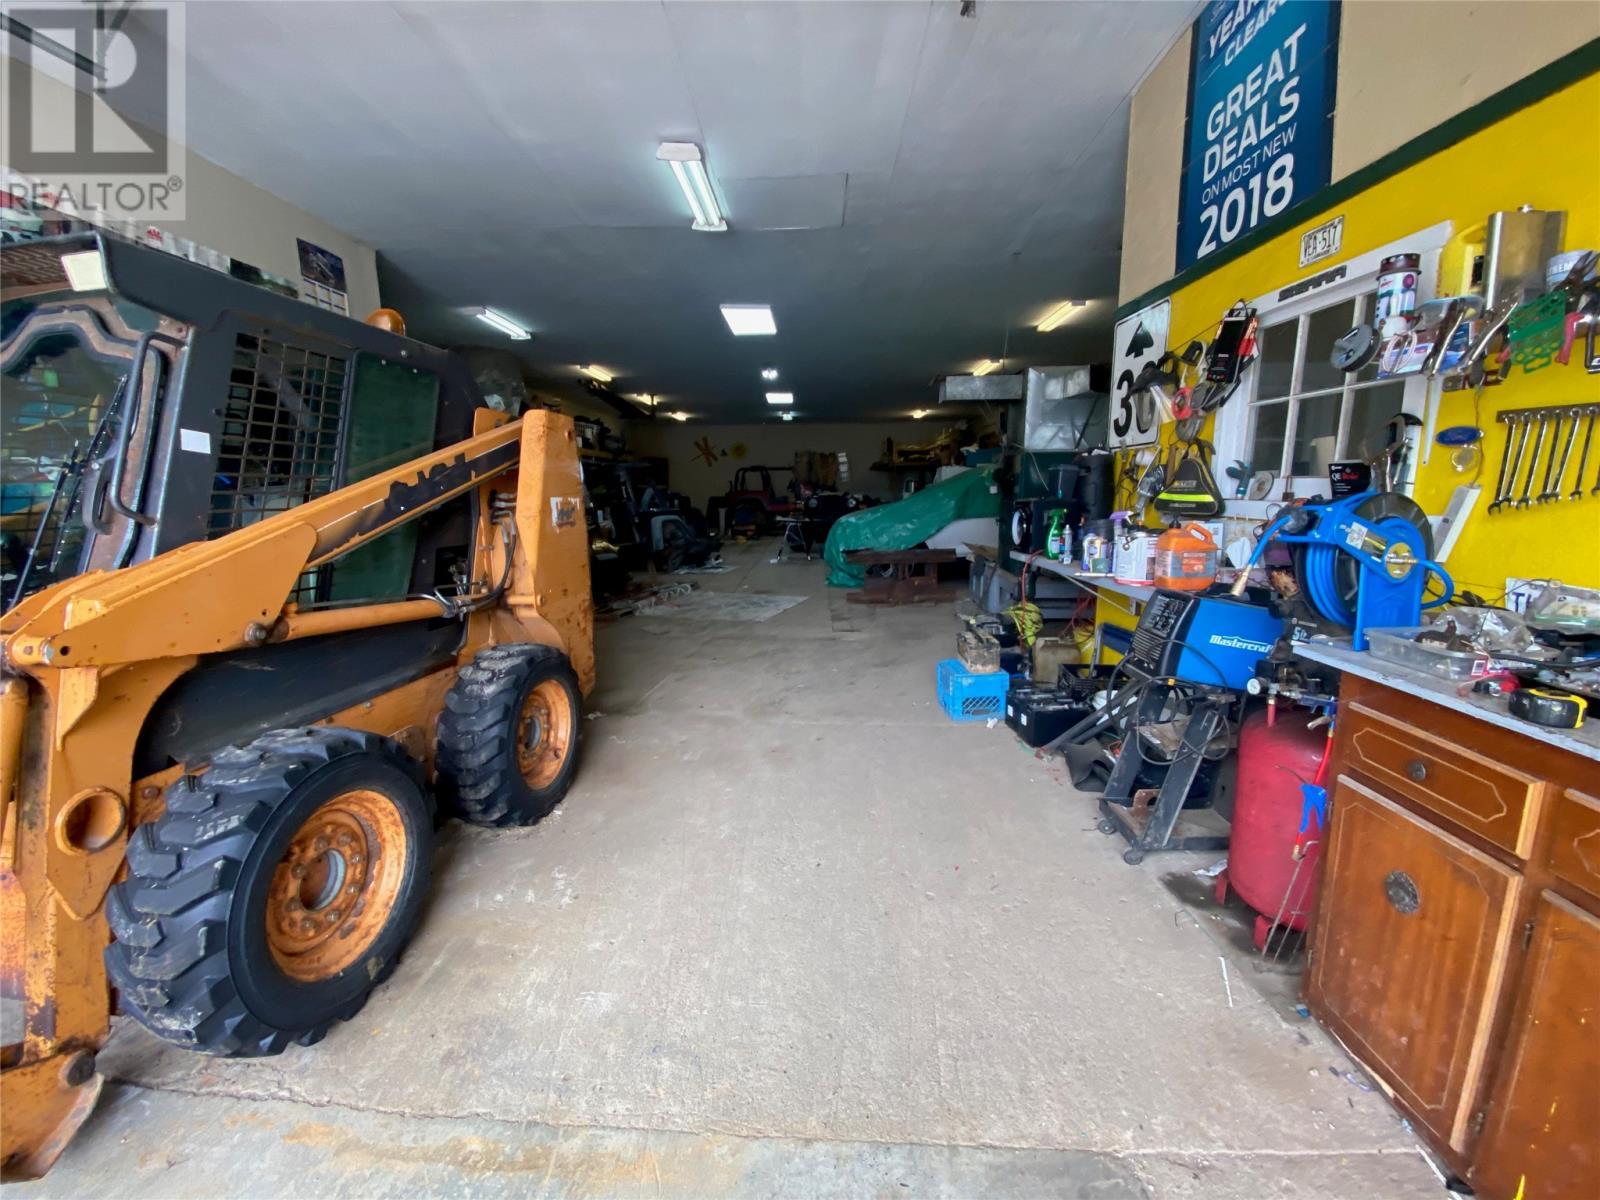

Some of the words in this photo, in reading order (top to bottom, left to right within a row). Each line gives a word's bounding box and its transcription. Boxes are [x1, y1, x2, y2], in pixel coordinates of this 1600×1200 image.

[1206, 23, 1307, 141] GREAT
[1225, 0, 1287, 67] CLEAR
[1202, 180, 1220, 205] ON
[1222, 149, 1261, 192] MOST
[1262, 122, 1297, 162] NEW
[1203, 76, 1301, 184] DEALS
[1197, 153, 1294, 260] 2018
